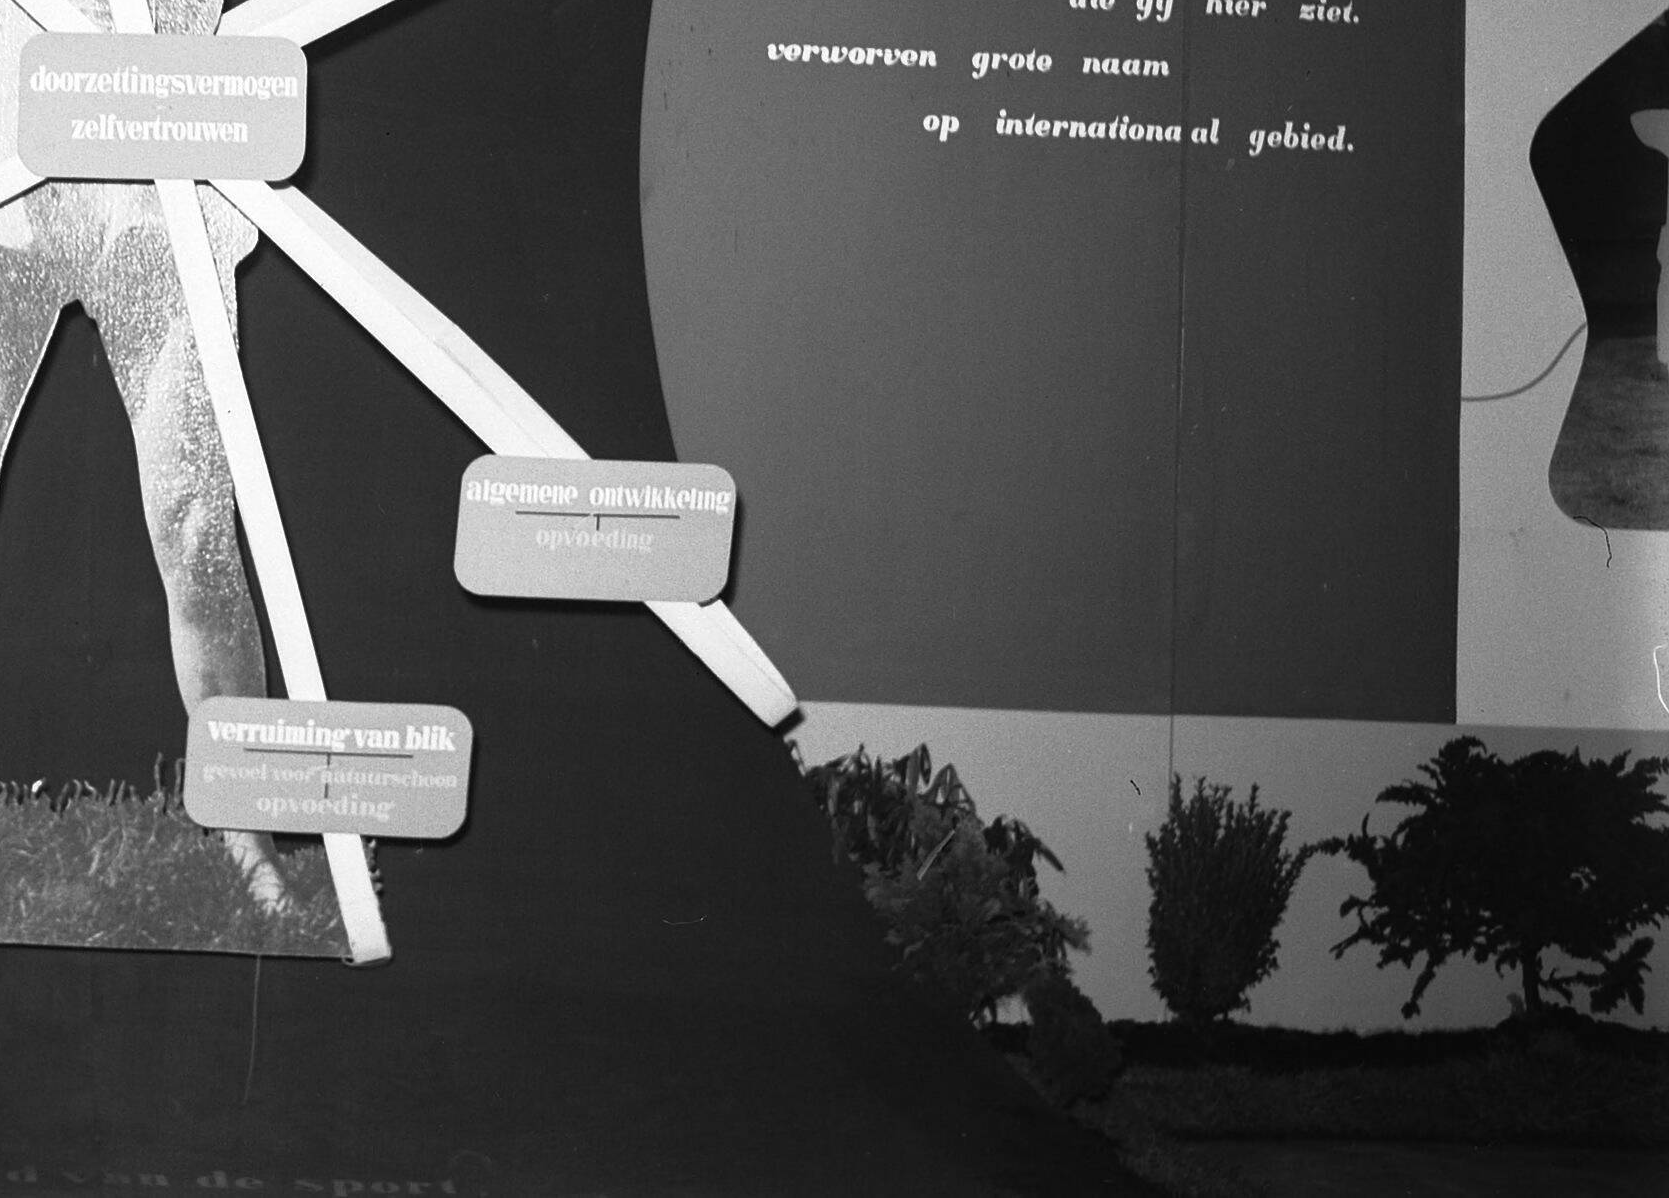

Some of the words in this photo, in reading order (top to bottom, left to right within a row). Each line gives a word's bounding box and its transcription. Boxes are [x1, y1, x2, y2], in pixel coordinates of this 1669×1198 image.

[766, 41, 938, 68] verworven
[971, 48, 1053, 79] grote
[1082, 55, 1170, 77] naam
[30, 65, 299, 100] doorzettingsvermogen
[71, 113, 249, 143] zelfvertrouwen
[923, 113, 960, 142] op
[1249, 120, 1355, 156] gebied.
[466, 479, 578, 506] algemene
[589, 484, 731, 515] ontwikkeling
[535, 527, 655, 553] opvoeding
[207, 718, 352, 752] verruiming
[353, 728, 401, 750] van
[404, 725, 456, 751] blik
[255, 792, 396, 823] opvoeding
[195, 1169, 265, 1189] de
